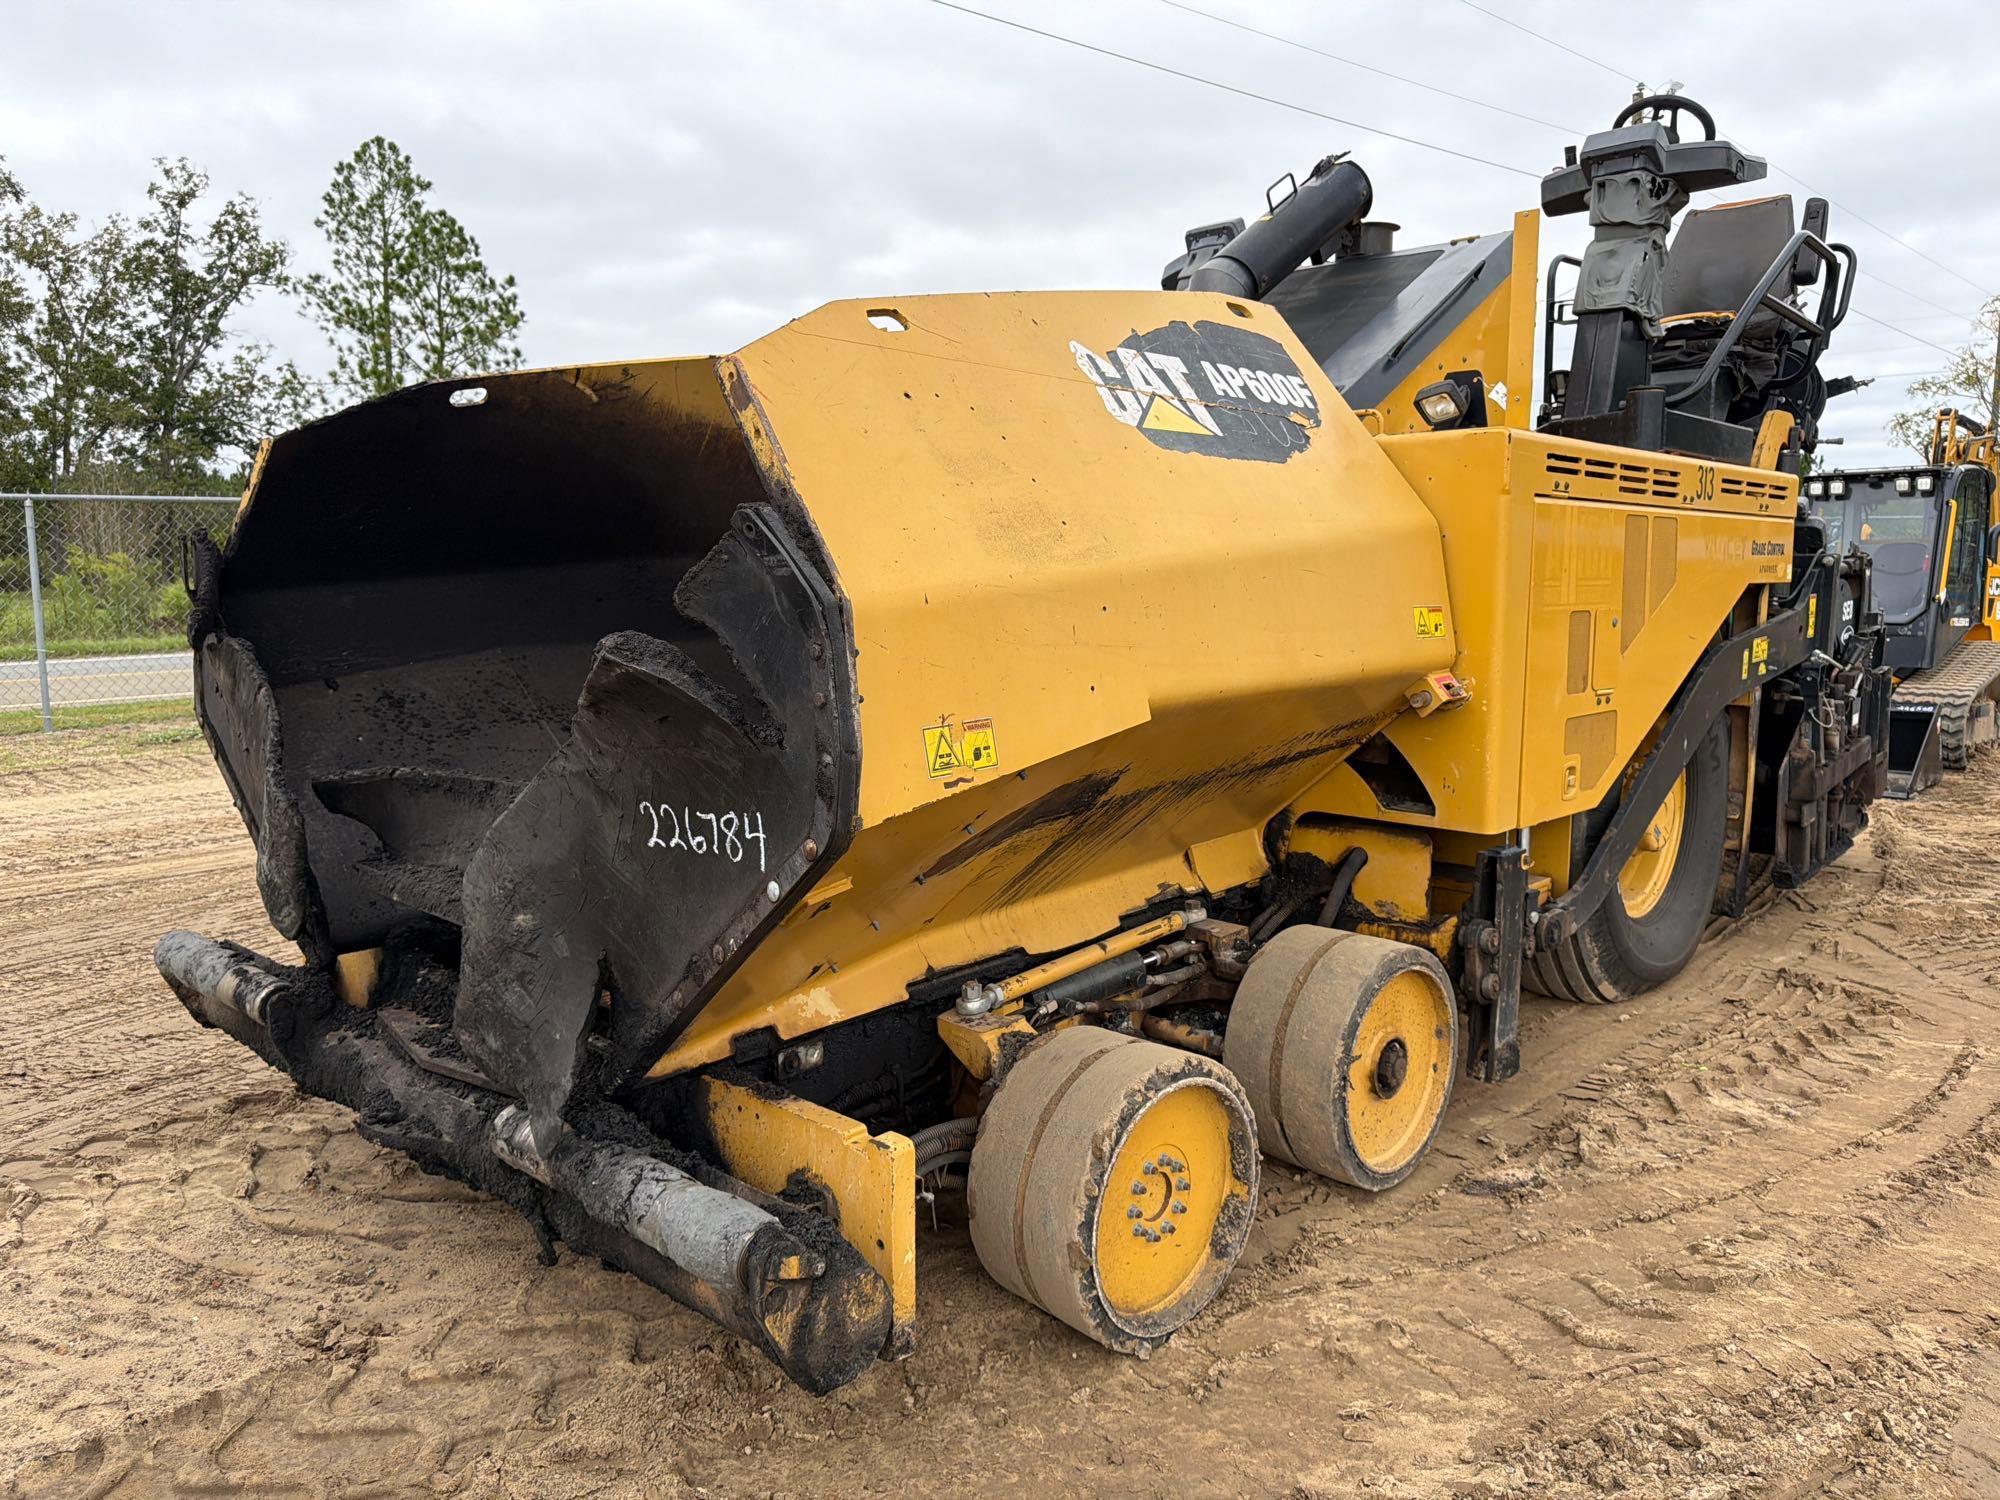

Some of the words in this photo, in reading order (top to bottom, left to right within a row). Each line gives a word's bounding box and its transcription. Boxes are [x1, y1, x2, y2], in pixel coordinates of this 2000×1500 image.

[1069, 340, 1224, 437] CAT
[1200, 361, 1316, 409] AP600F
[1696, 465, 1715, 501] 313
[966, 722, 991, 731] WARNING
[639, 801, 767, 873] 226784
